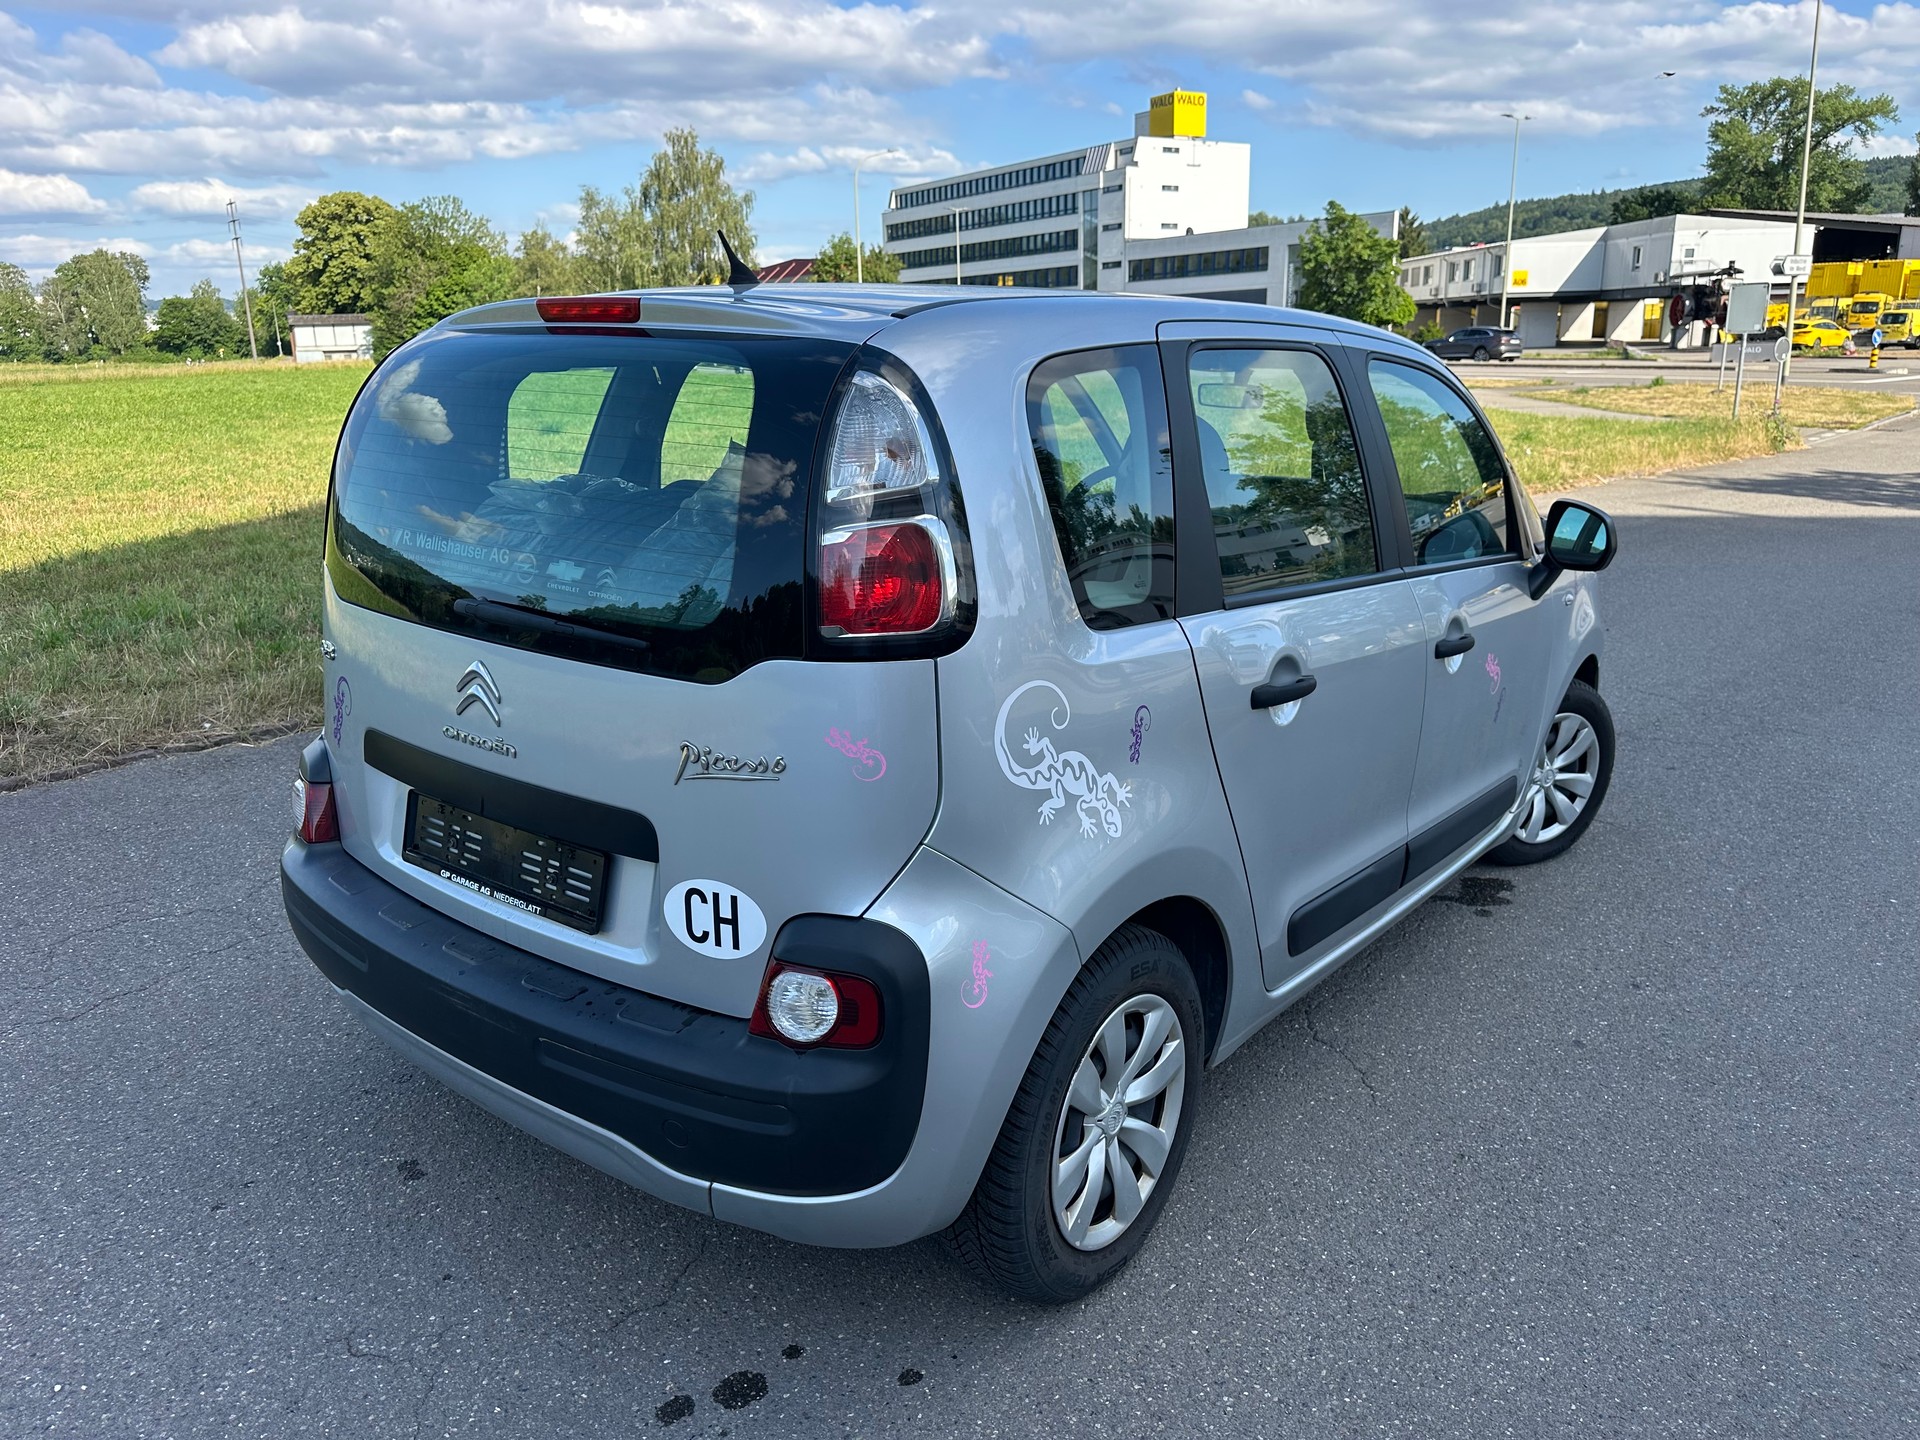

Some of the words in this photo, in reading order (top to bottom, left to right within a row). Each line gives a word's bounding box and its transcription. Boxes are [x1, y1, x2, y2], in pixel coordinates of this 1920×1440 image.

[1151, 95, 1173, 109] WALO
[1176, 94, 1205, 106] WALO
[402, 530, 413, 545] R.
[416, 532, 488, 560] Wallishauser
[489, 548, 509, 564] AG
[547, 582, 579, 593] CHEVROLET
[674, 740, 787, 785] Picasso
[440, 869, 451, 880] GP
[451, 873, 479, 891] GARAGE
[480, 885, 491, 896] AG
[493, 890, 542, 915] NIEDERGLATT
[683, 887, 741, 950] CH
